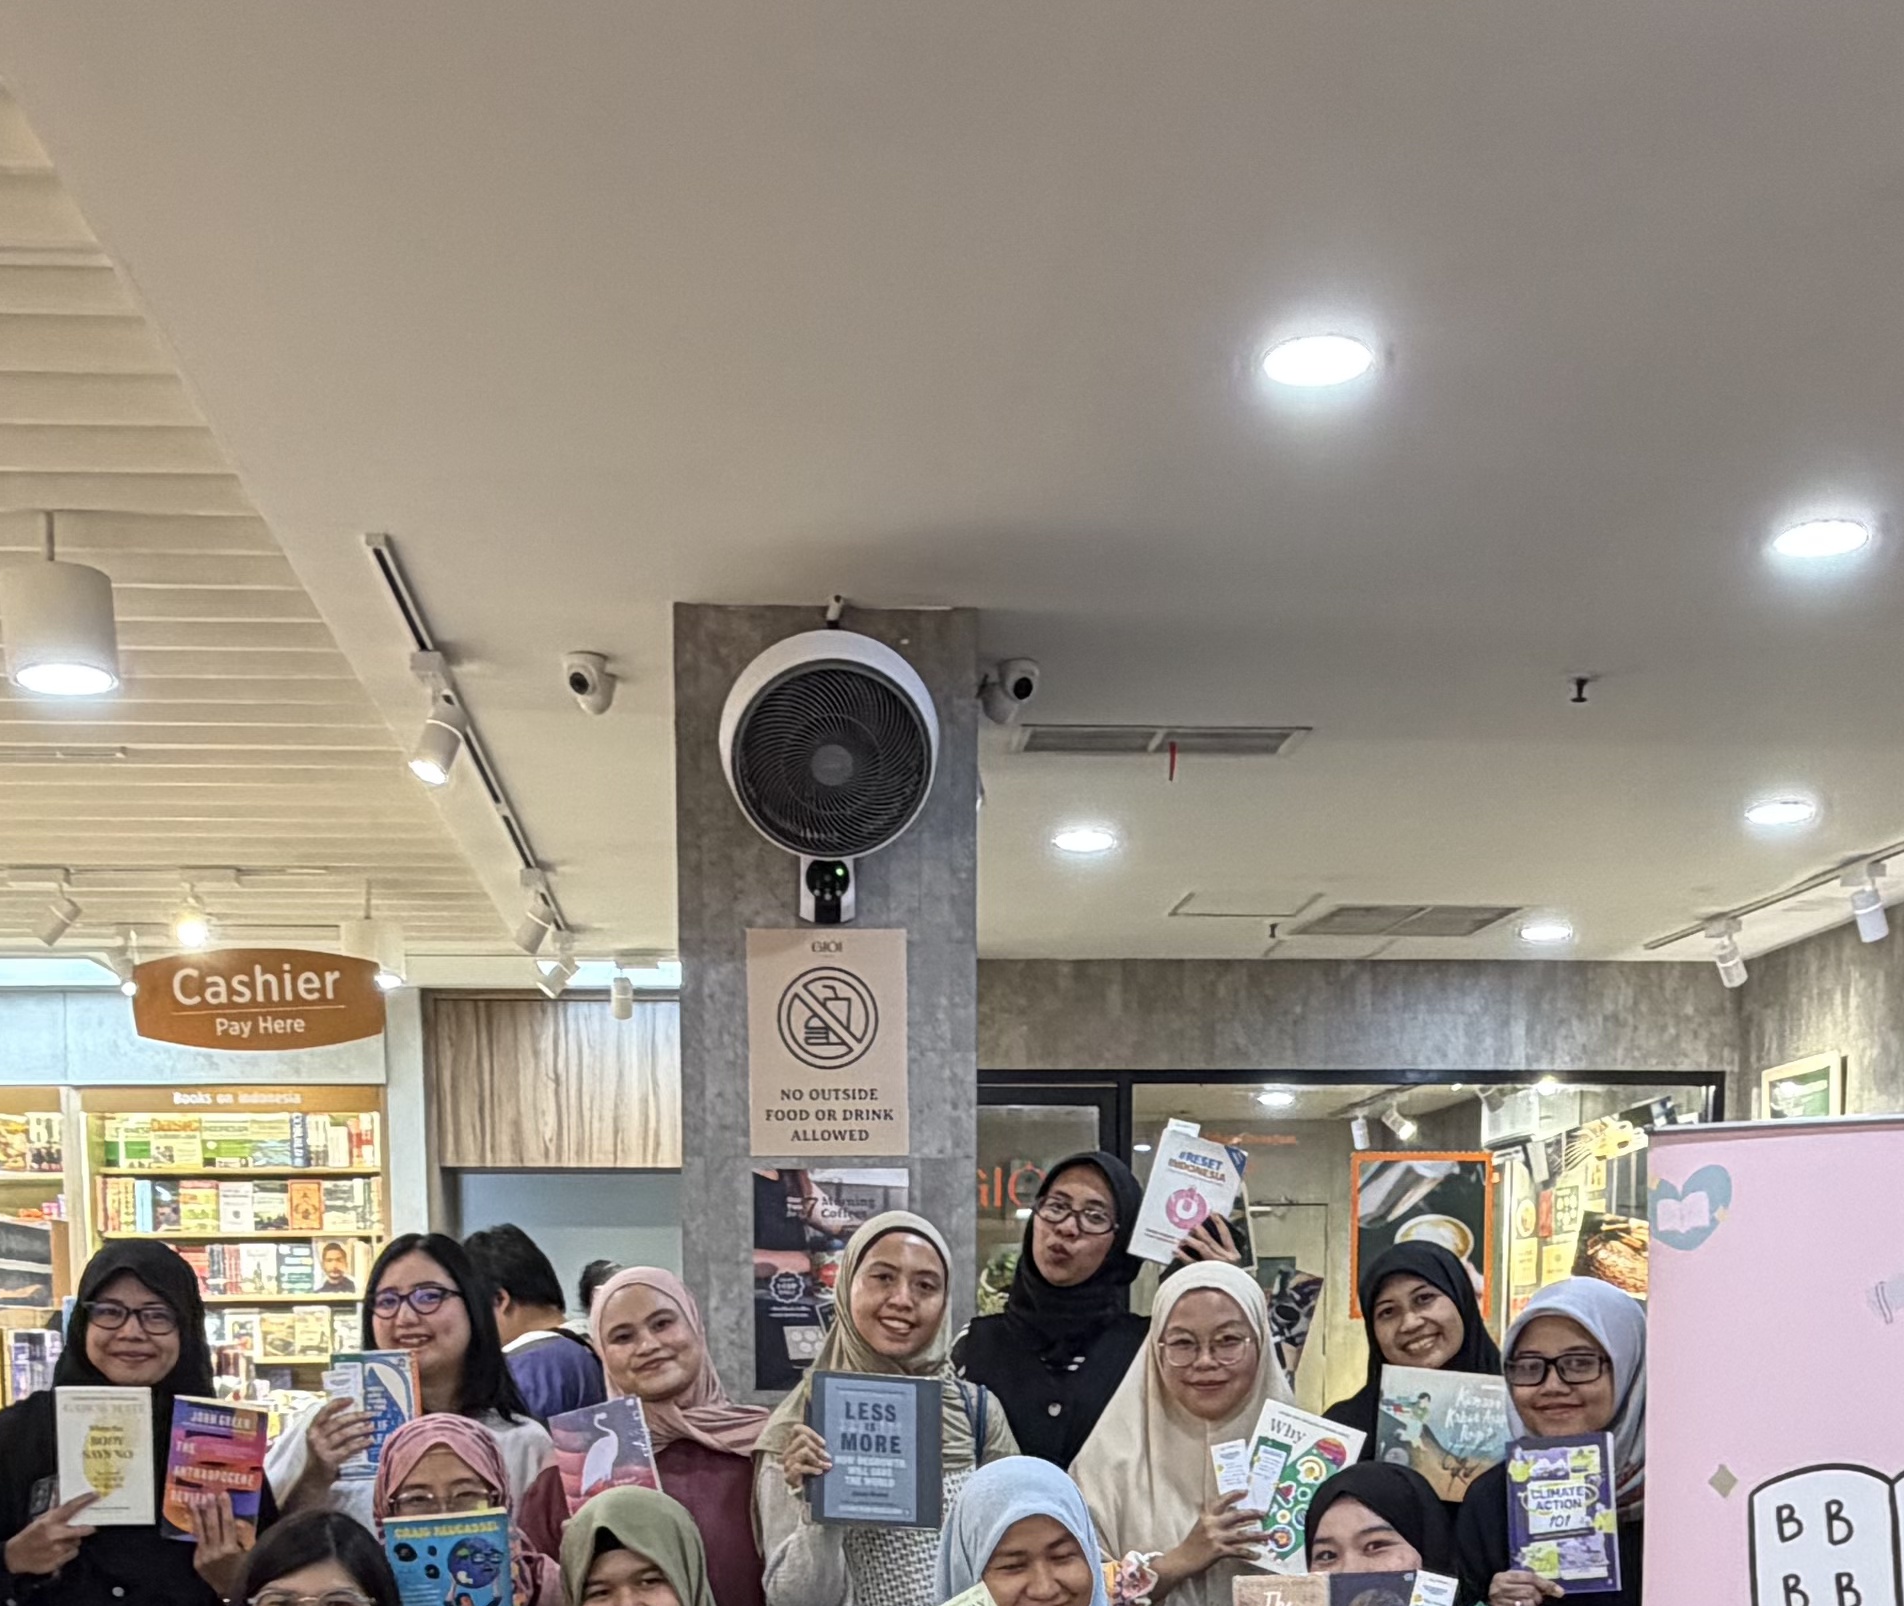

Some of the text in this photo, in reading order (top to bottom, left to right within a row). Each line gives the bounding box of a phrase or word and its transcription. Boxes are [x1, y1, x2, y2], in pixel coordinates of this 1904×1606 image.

[172, 963, 340, 1007] Cashier
[216, 1016, 305, 1039] Pay Here
[172, 1091, 301, 1106] Books on Indonesia
[780, 1088, 879, 1101] NO OUTSIDE
[765, 1108, 895, 1121] FOOD OR DRINK
[790, 1129, 870, 1142] ALLOWED
[190, 1411, 218, 1425] JOHN
[844, 1401, 897, 1422] LESS
[1270, 1417, 1307, 1444] Why
[90, 1435, 123, 1447] BODY
[840, 1432, 902, 1454] MORE
[1530, 1485, 1586, 1500] CLIMATE
[1535, 1498, 1582, 1511] ACTION
[1775, 1499, 1854, 1545] B B
